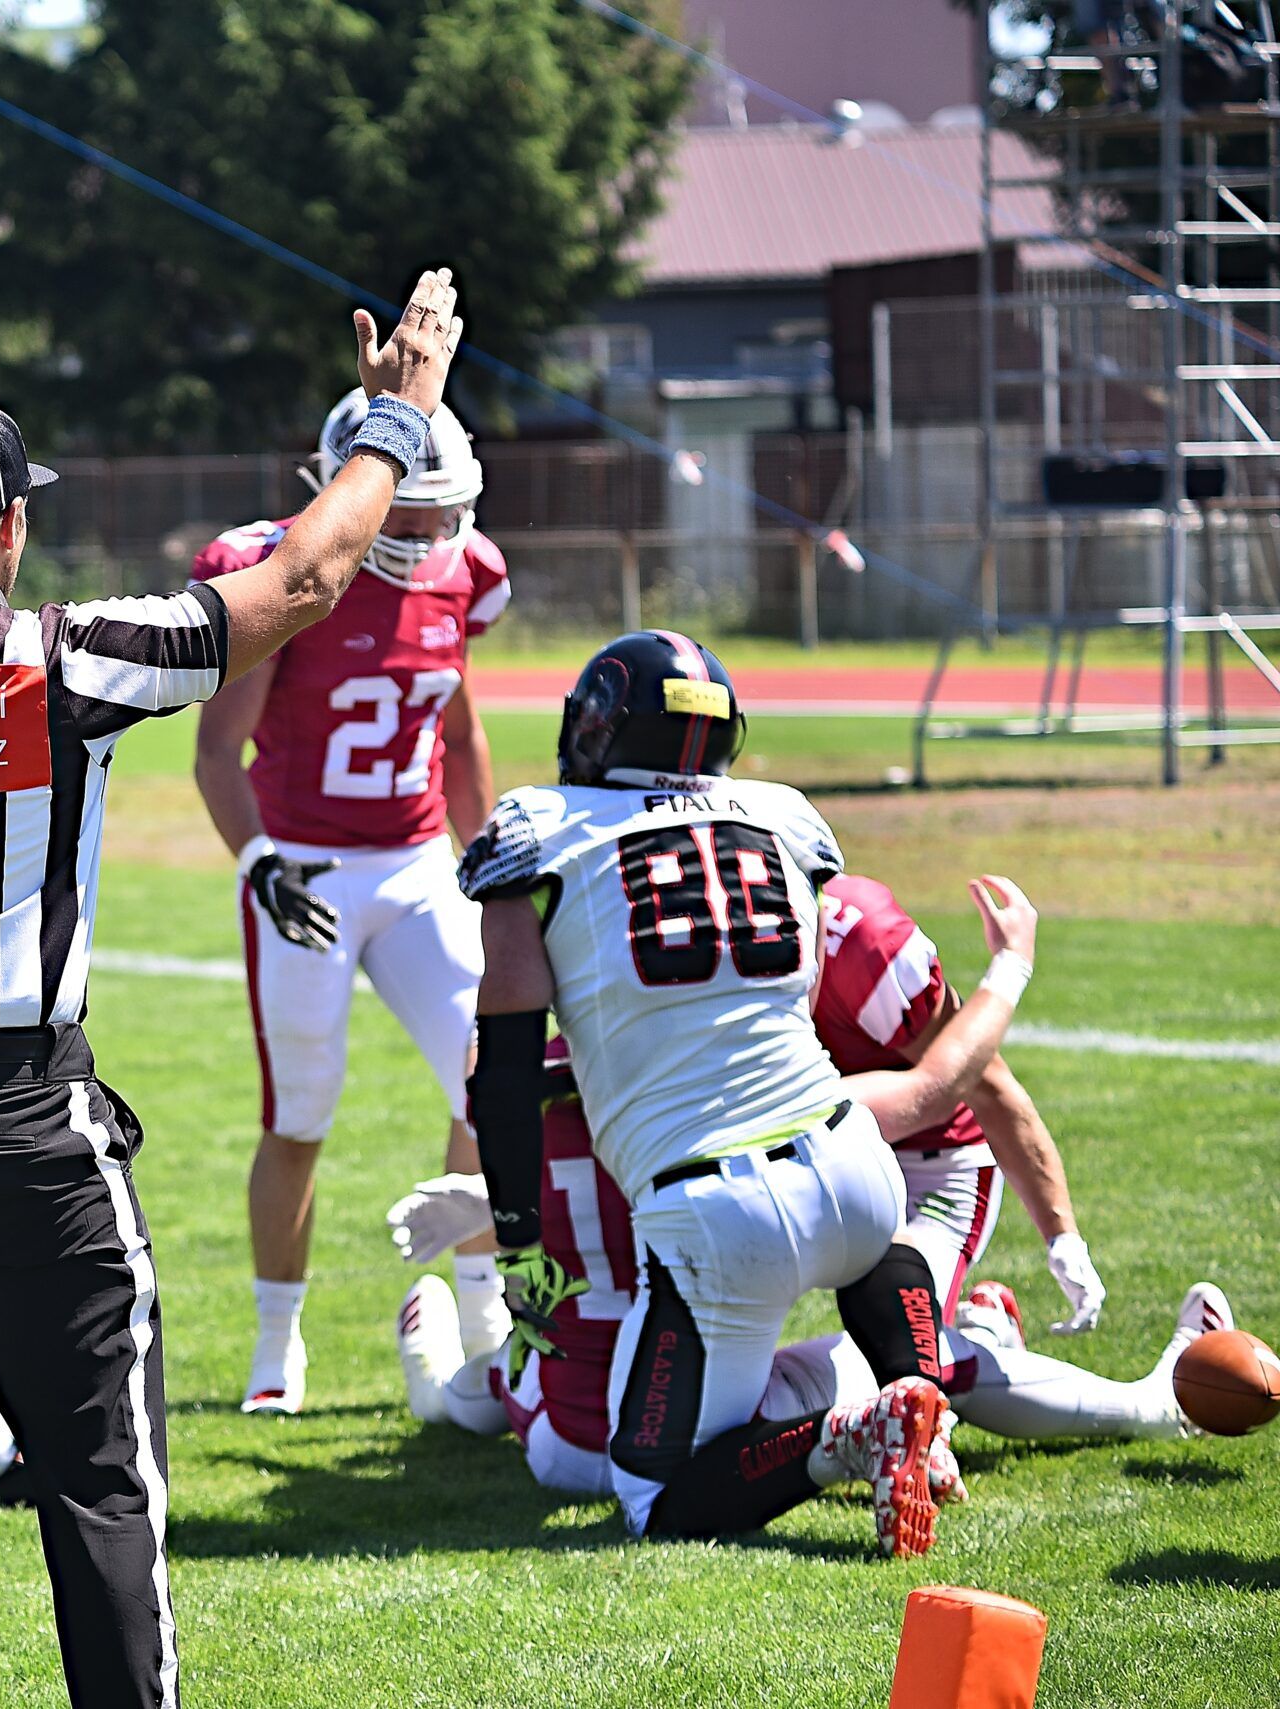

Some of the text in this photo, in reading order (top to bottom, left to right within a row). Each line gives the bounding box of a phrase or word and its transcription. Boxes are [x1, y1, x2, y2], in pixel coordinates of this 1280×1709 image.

[323, 667, 462, 799] 27
[644, 793, 748, 816] FIALA
[619, 820, 803, 987] 88
[633, 1330, 678, 1448] GLADIATORS
[898, 1287, 940, 1378] GLADIATORS
